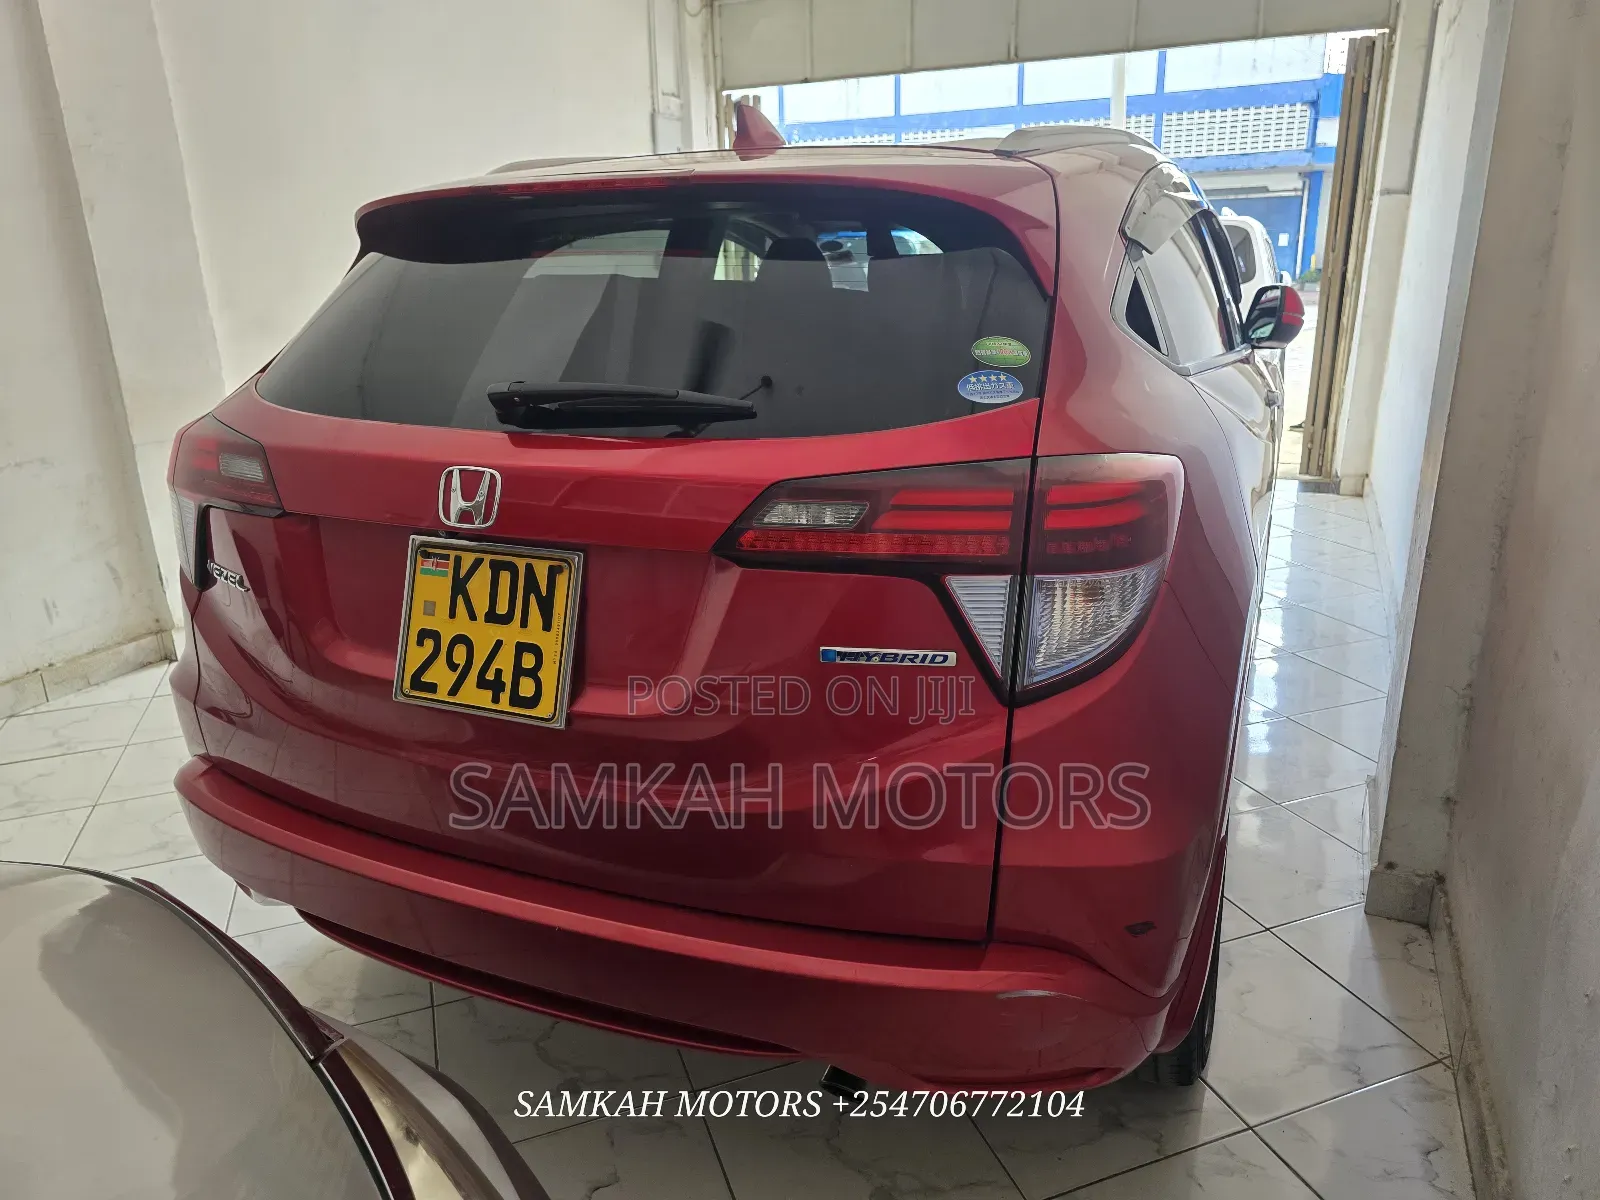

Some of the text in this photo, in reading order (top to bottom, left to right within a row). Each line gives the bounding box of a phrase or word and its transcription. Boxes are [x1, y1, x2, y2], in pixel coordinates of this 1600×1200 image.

[448, 554, 560, 633] KDN
[409, 627, 544, 710] 294B
[836, 651, 949, 665] HYBRID
